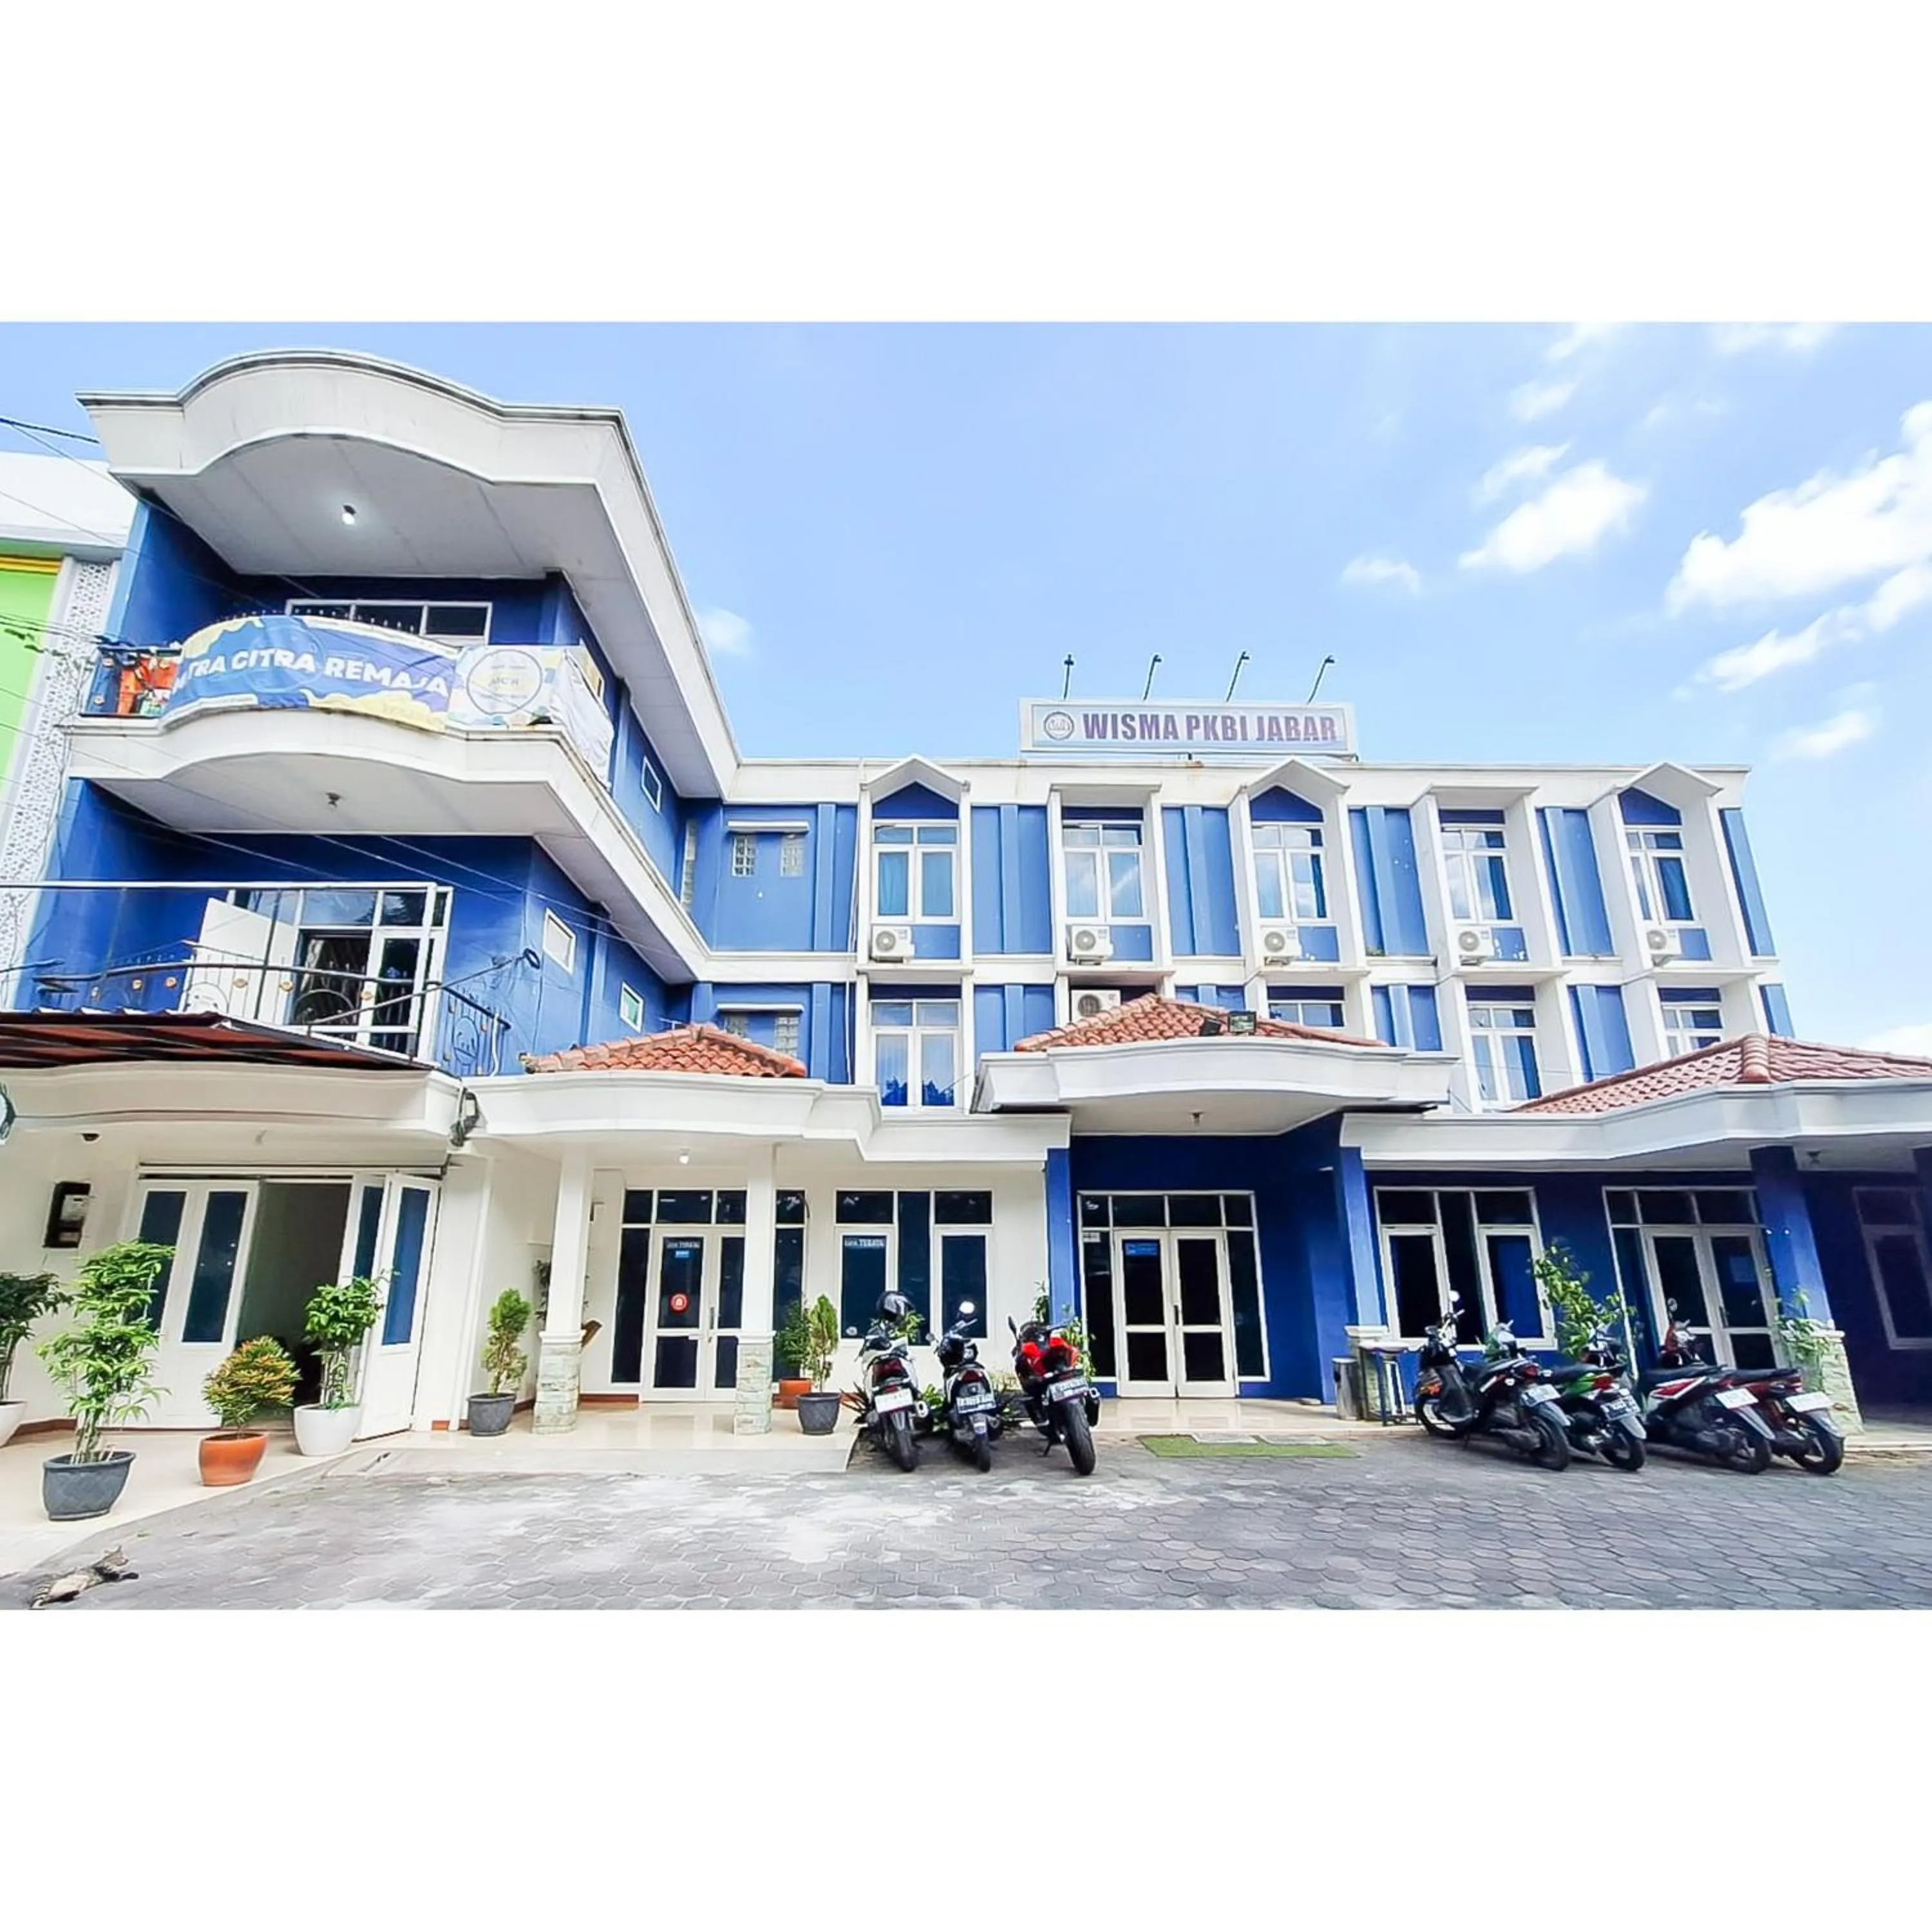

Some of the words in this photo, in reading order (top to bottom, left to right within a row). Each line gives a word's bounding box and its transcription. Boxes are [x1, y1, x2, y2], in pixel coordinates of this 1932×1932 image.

[232, 648, 316, 672] CITRA
[325, 657, 449, 697] REMAJA
[1083, 714, 1179, 740] WISMA
[1186, 715, 1248, 741] PKBI
[1257, 715, 1337, 742] JABAR
